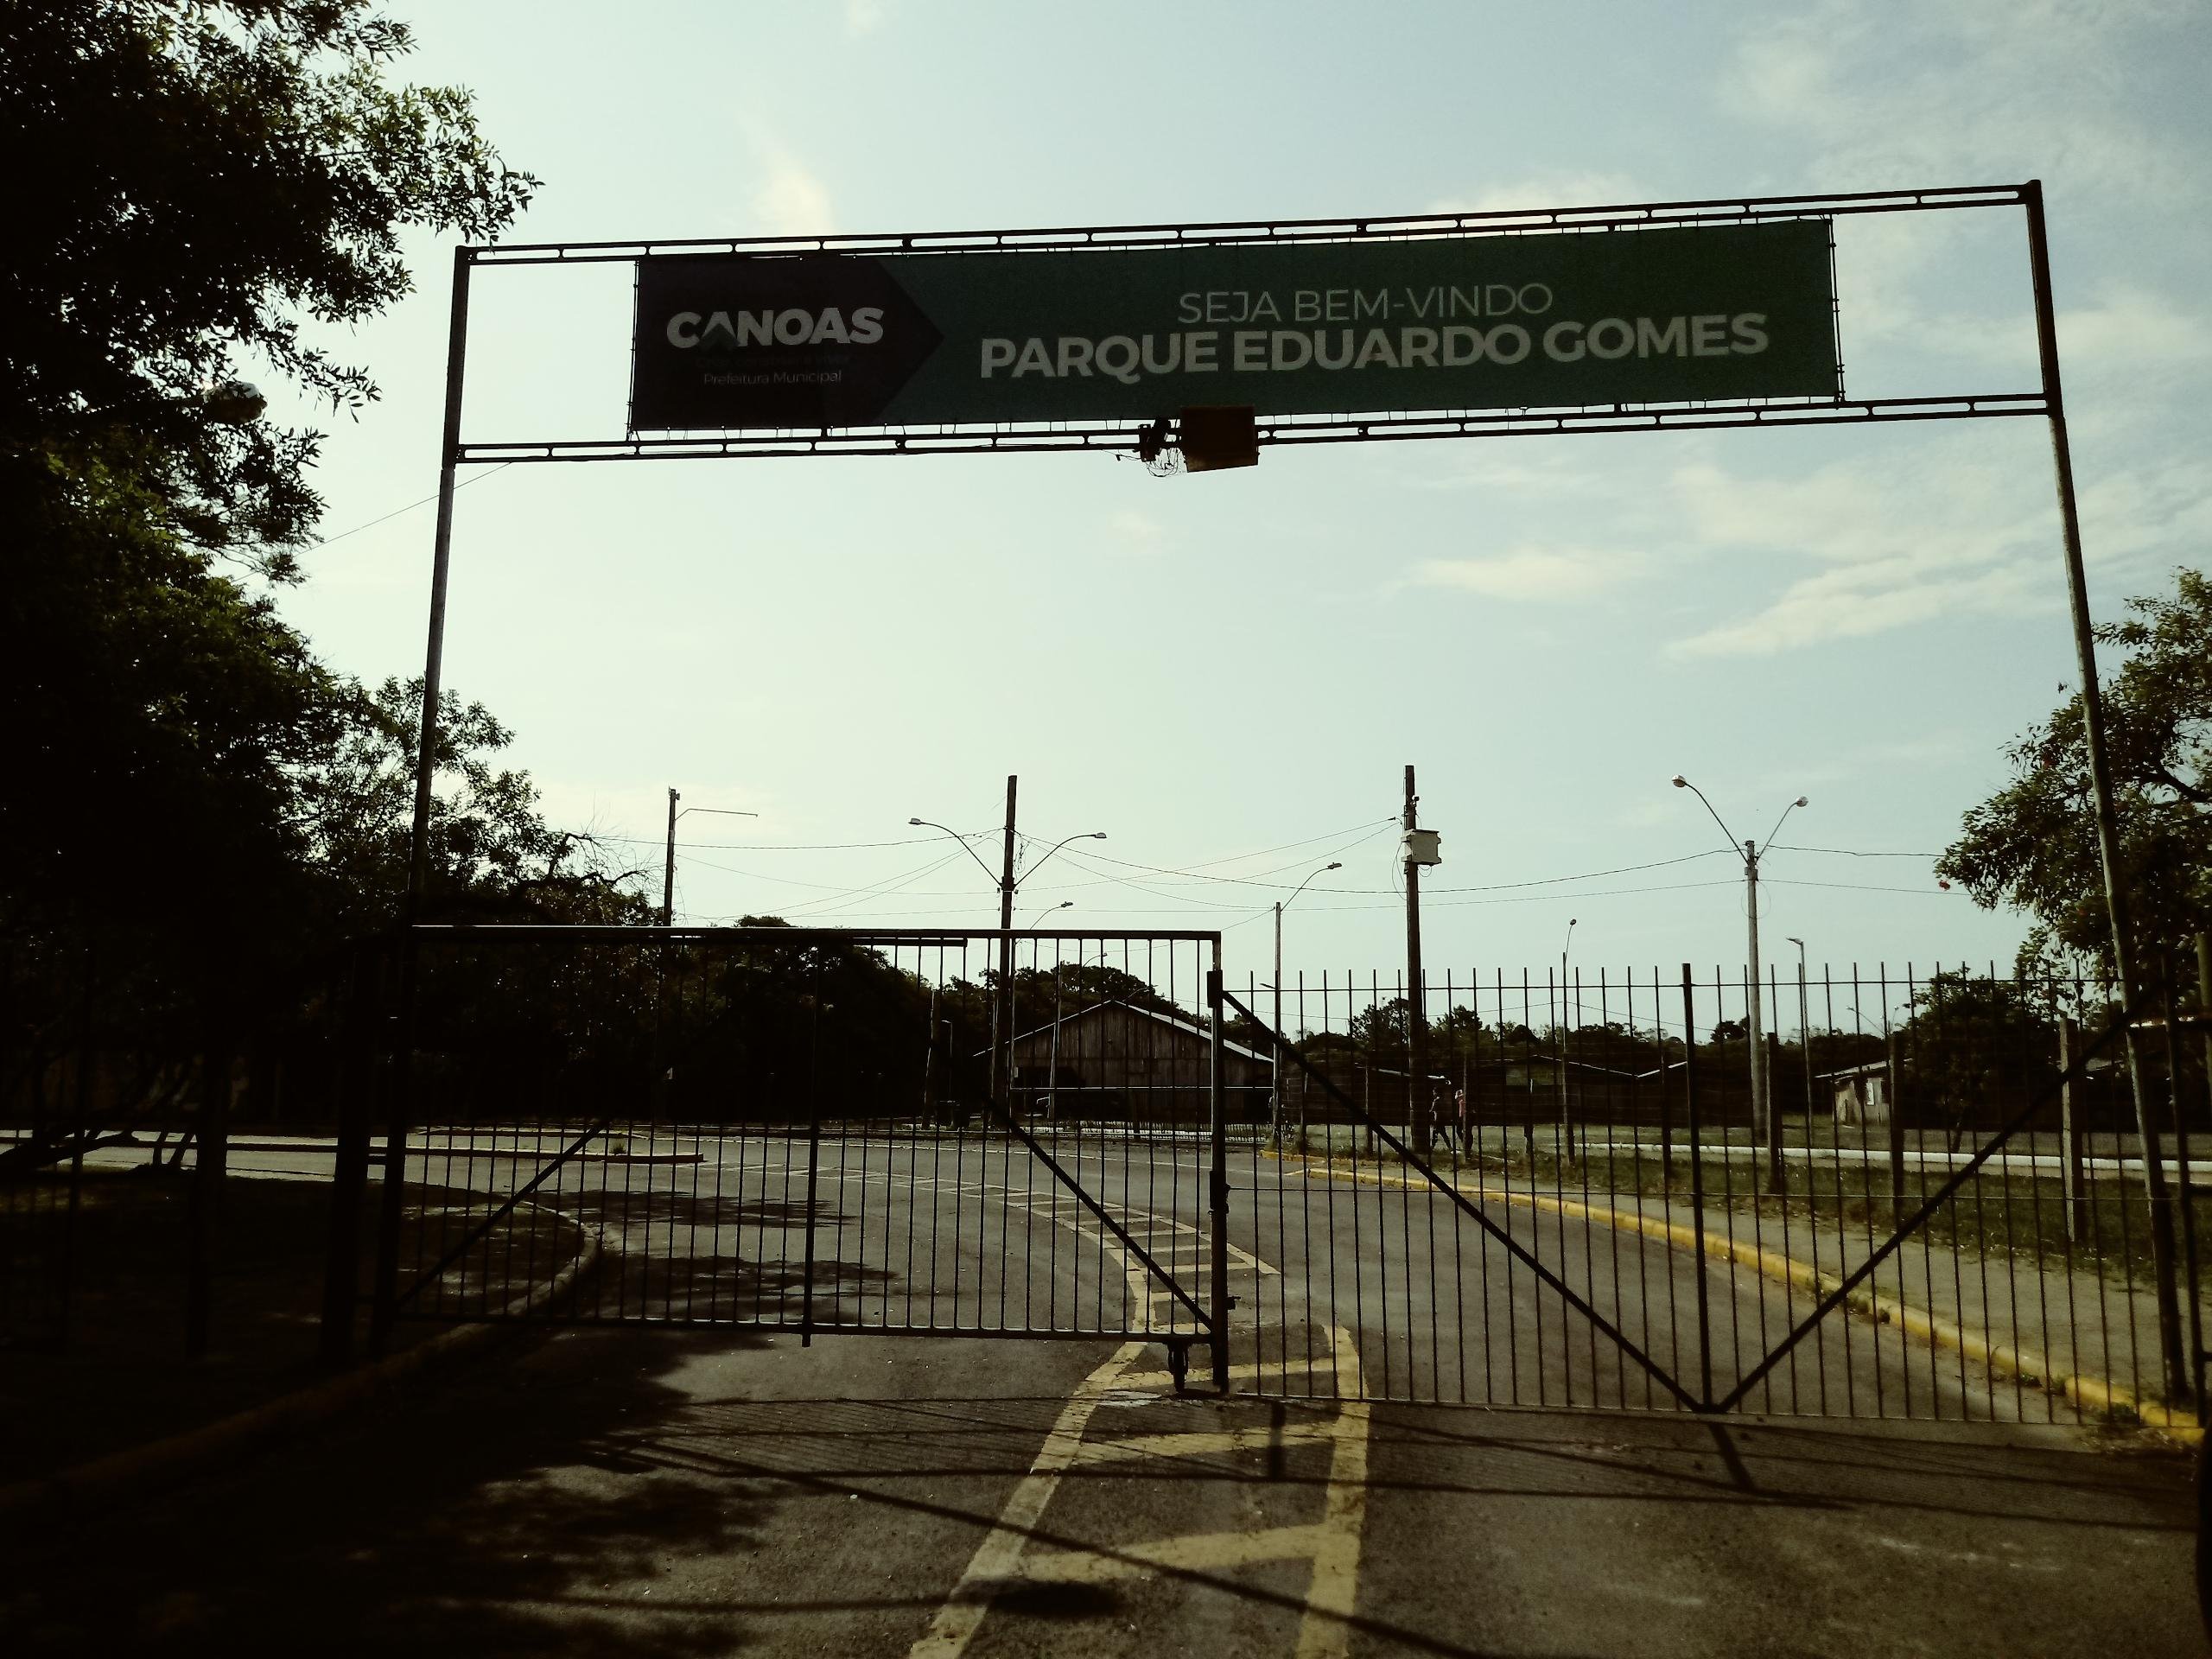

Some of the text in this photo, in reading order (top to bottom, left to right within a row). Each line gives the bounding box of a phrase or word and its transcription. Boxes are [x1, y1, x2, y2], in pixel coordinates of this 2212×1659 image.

[1178, 283, 1553, 323] SEJA BEM-VINDO
[667, 307, 885, 348] CANOAS
[981, 313, 1769, 384] PARQUE EDUARDO GOMES
[703, 370, 843, 385] Prefeitura Municipal
